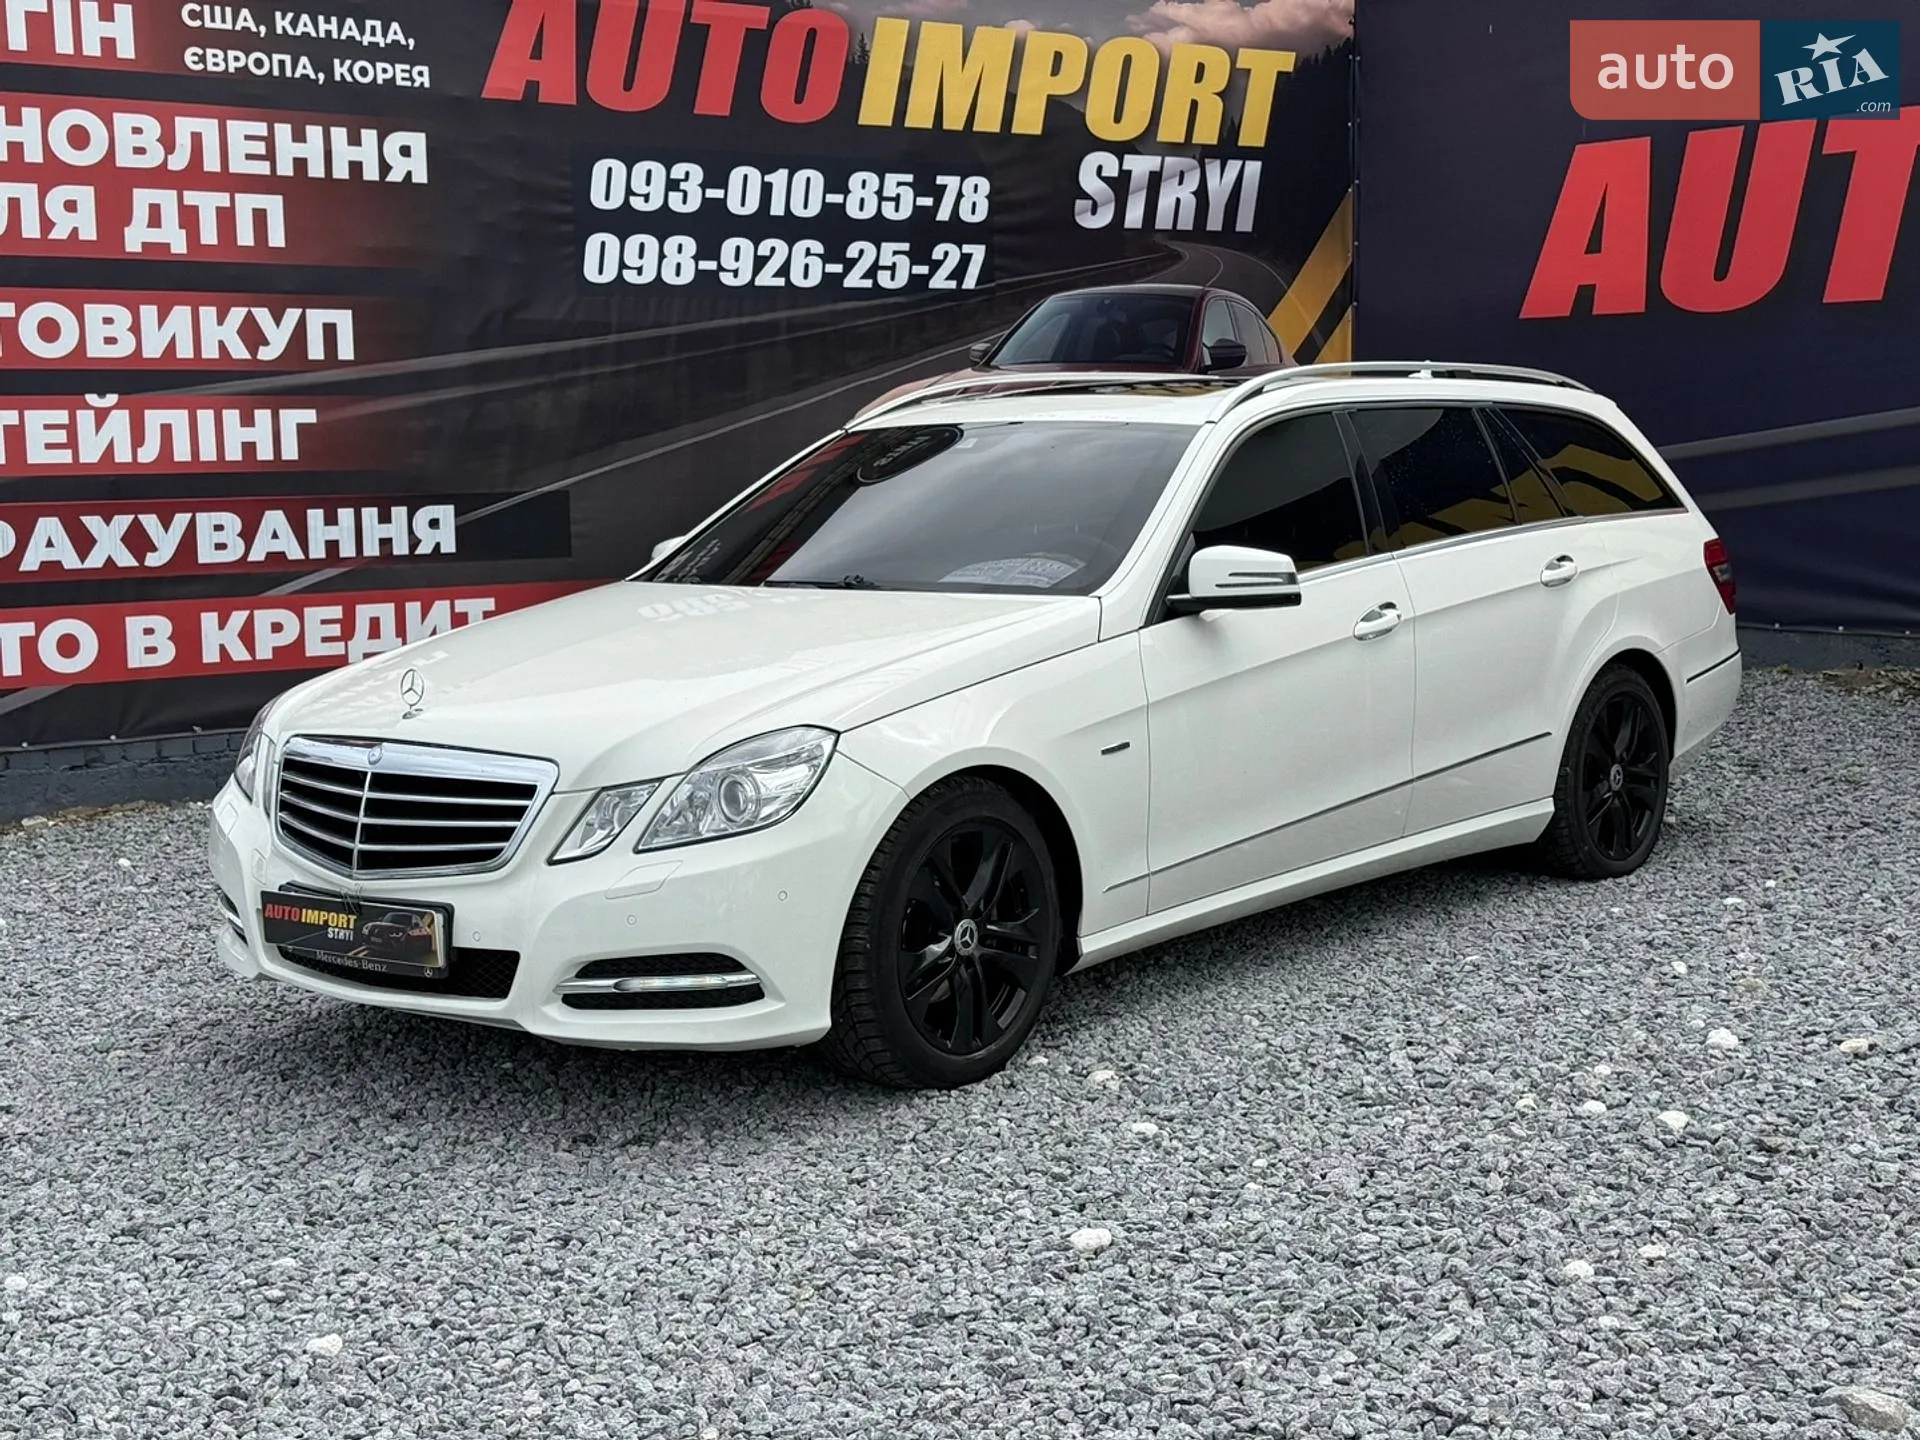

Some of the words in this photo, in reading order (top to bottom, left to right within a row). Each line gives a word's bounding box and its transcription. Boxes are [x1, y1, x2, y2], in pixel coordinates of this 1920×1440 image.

[180, 3, 267, 38] США,
[275, 12, 416, 50] КАНАДА,
[184, 47, 324, 84] ЄВРОПА,
[333, 57, 431, 88] КОРЕЯ
[0, 106, 429, 184] НОВЛЕННЯ
[123, 187, 286, 254] ДТП
[590, 158, 990, 223] 093-010-85-78
[1074, 151, 1263, 232] STRYI
[582, 232, 987, 290] 098-926-25-27
[125, 615, 176, 669] В
